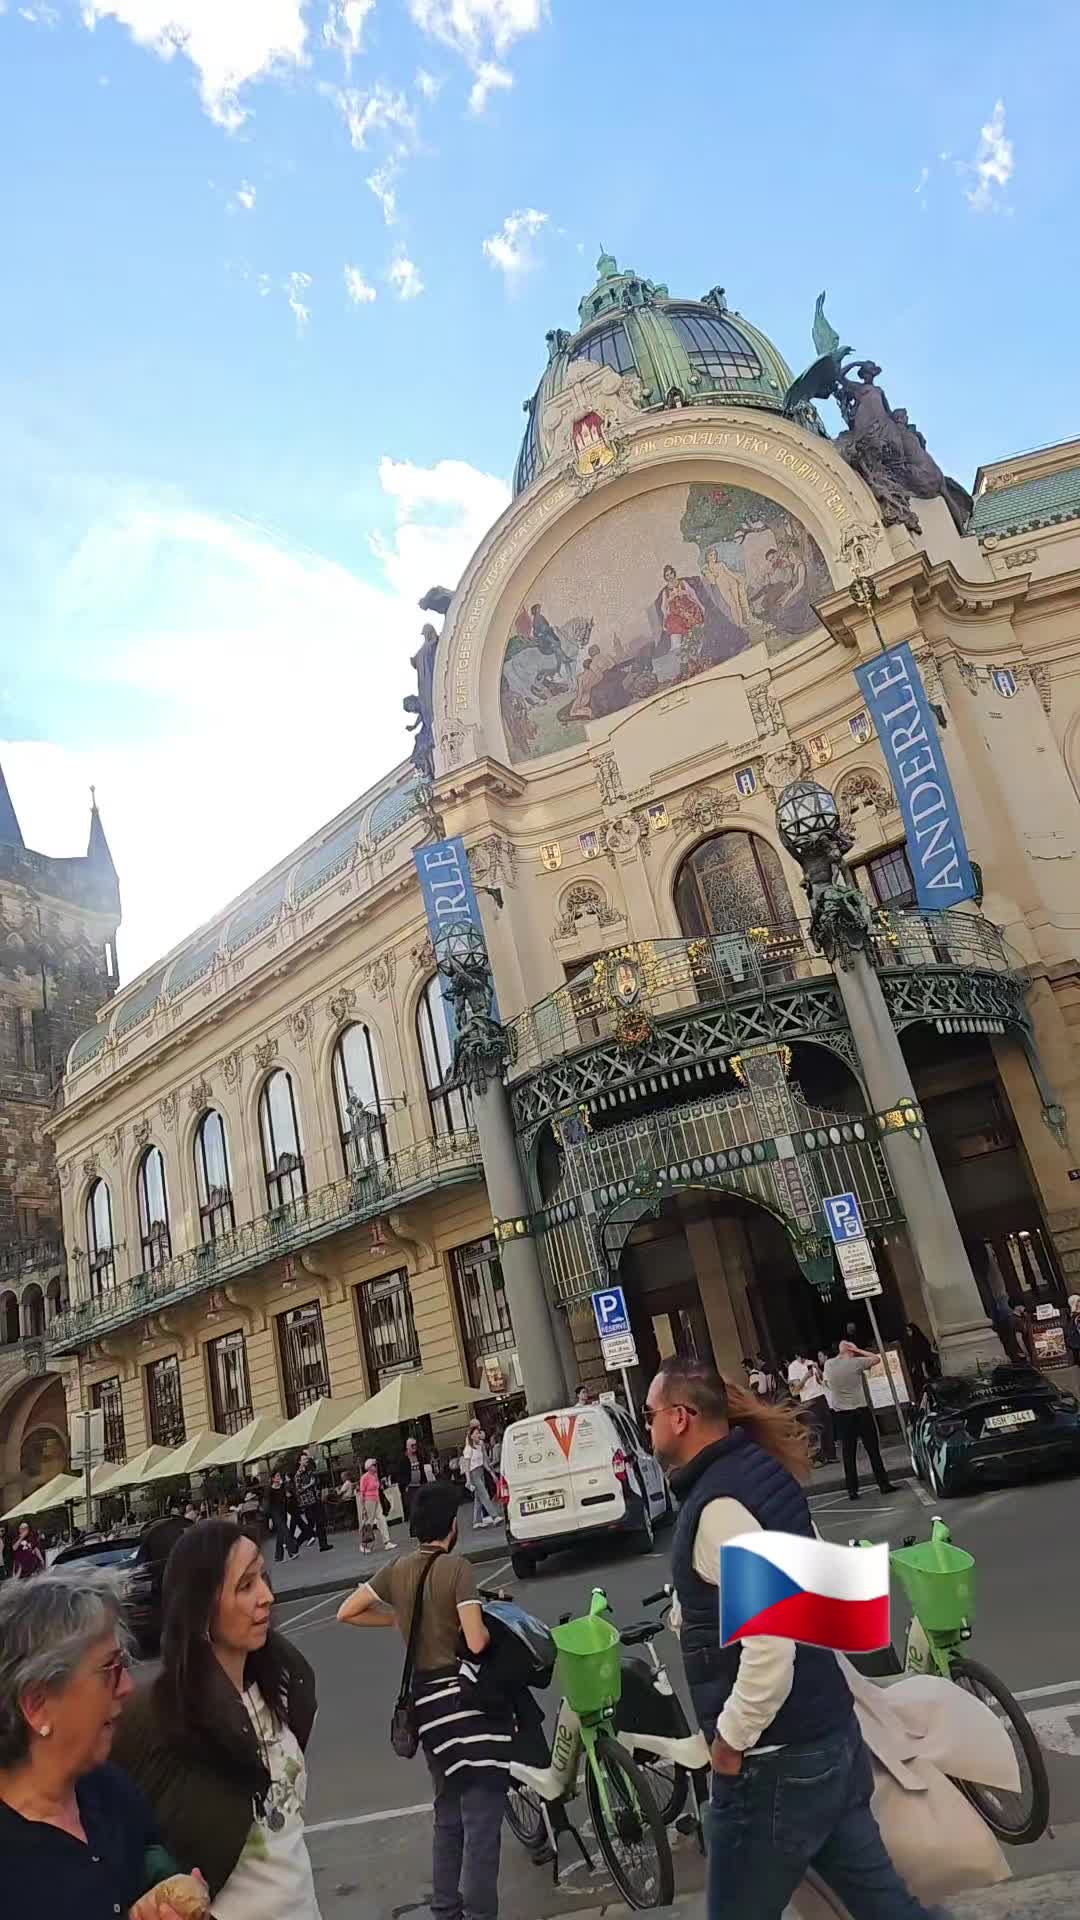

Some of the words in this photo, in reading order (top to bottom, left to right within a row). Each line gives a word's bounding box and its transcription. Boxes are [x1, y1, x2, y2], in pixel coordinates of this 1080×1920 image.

[867, 655, 963, 890] ANDERLE
[831, 1200, 851, 1228] P
[599, 1295, 618, 1322] P
